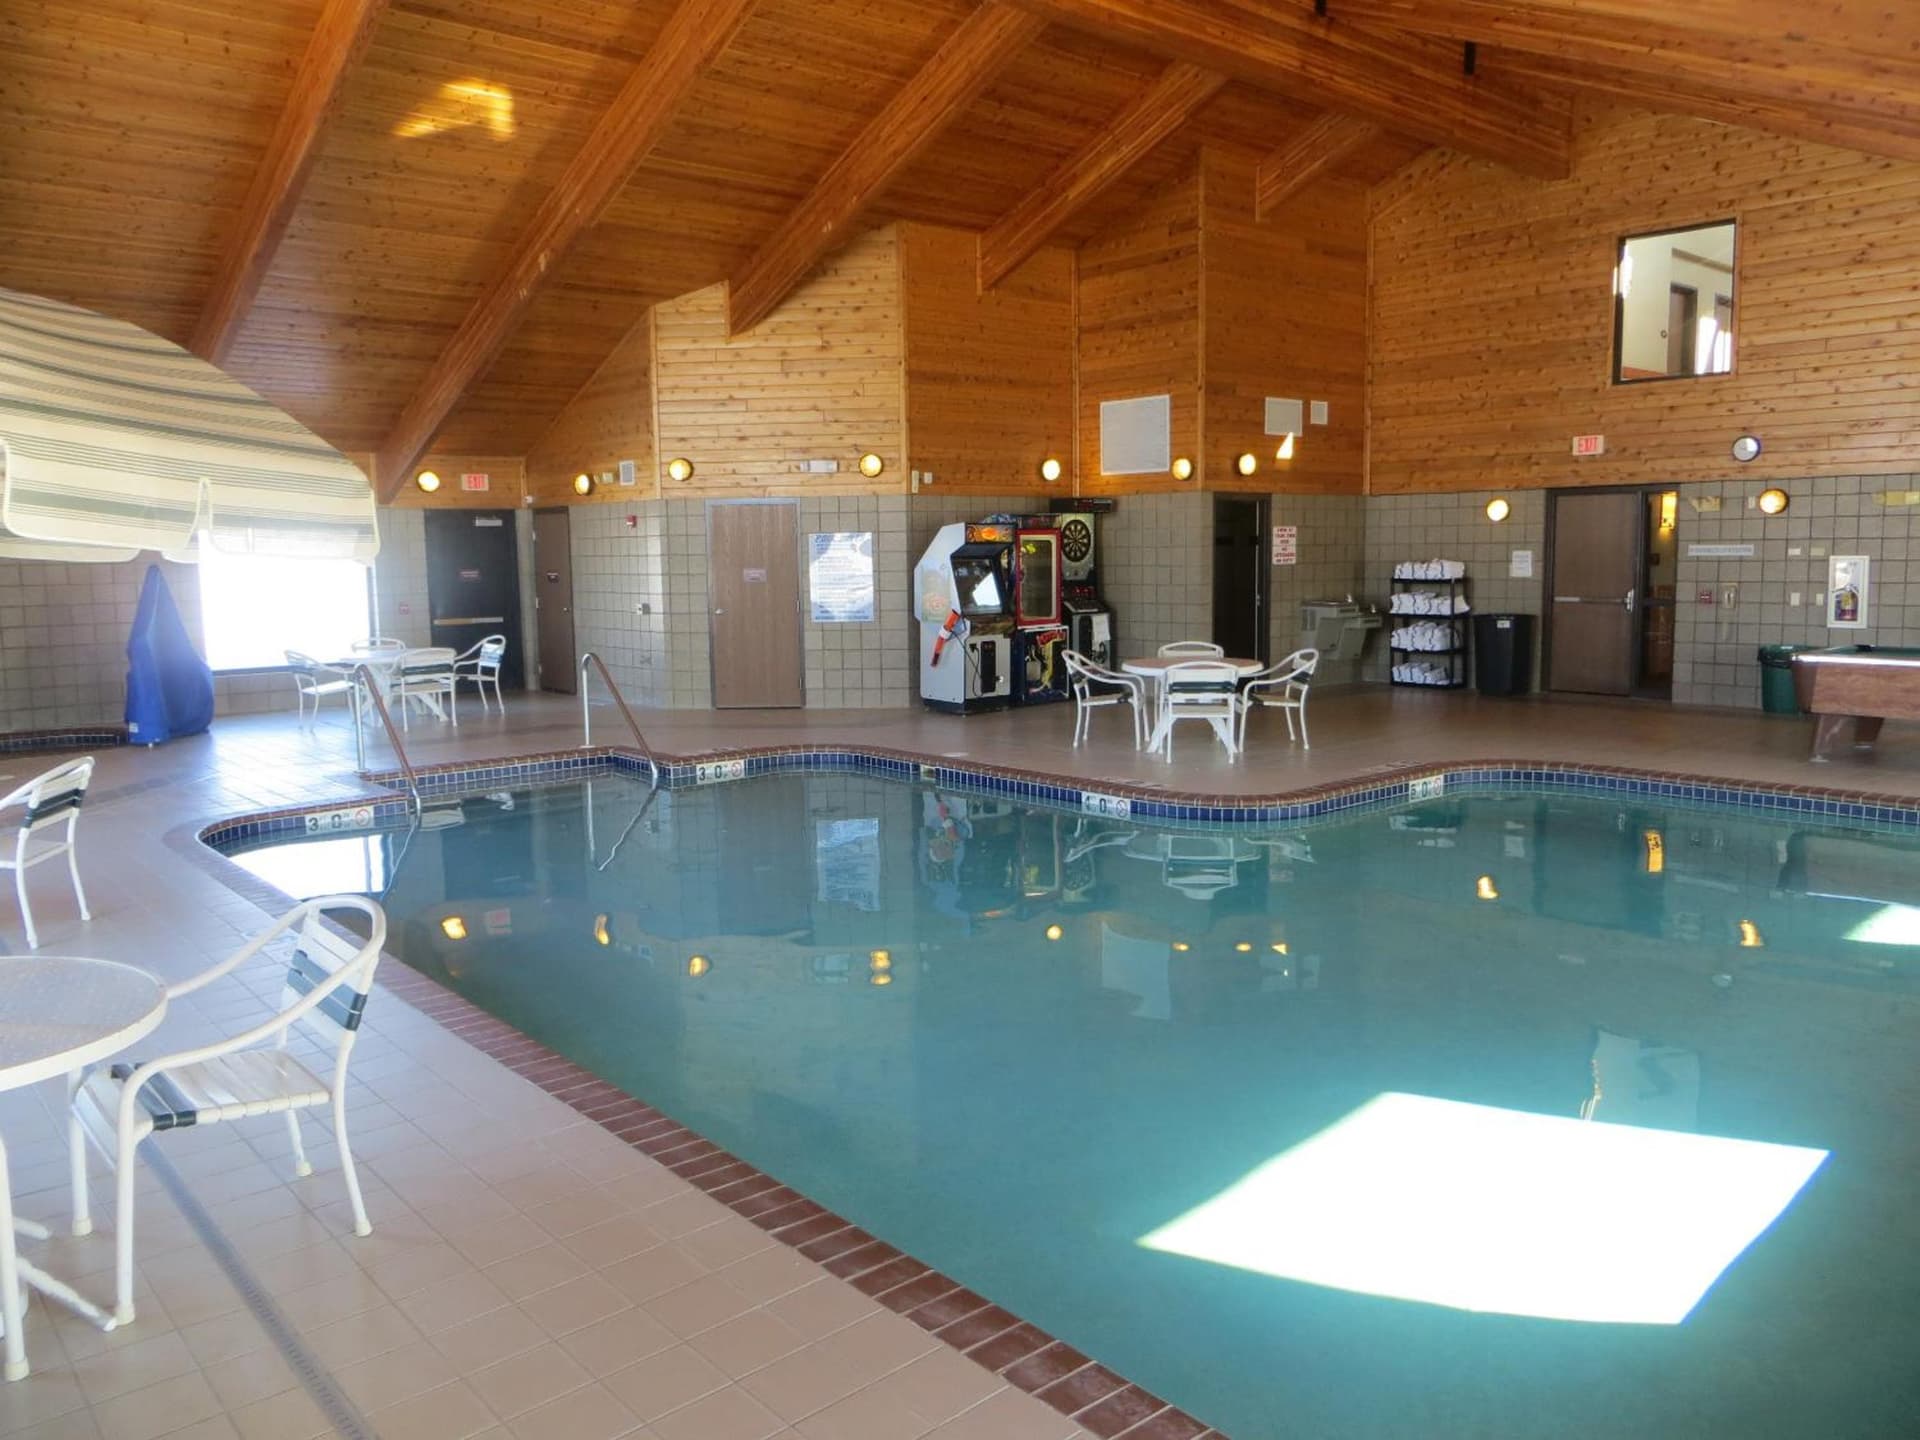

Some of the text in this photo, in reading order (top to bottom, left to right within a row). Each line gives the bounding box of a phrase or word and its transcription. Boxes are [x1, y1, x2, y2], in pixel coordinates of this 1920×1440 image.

[1577, 437, 1598, 453] EXIT
[699, 766, 706, 781] 3
[308, 817, 319, 832] 3
